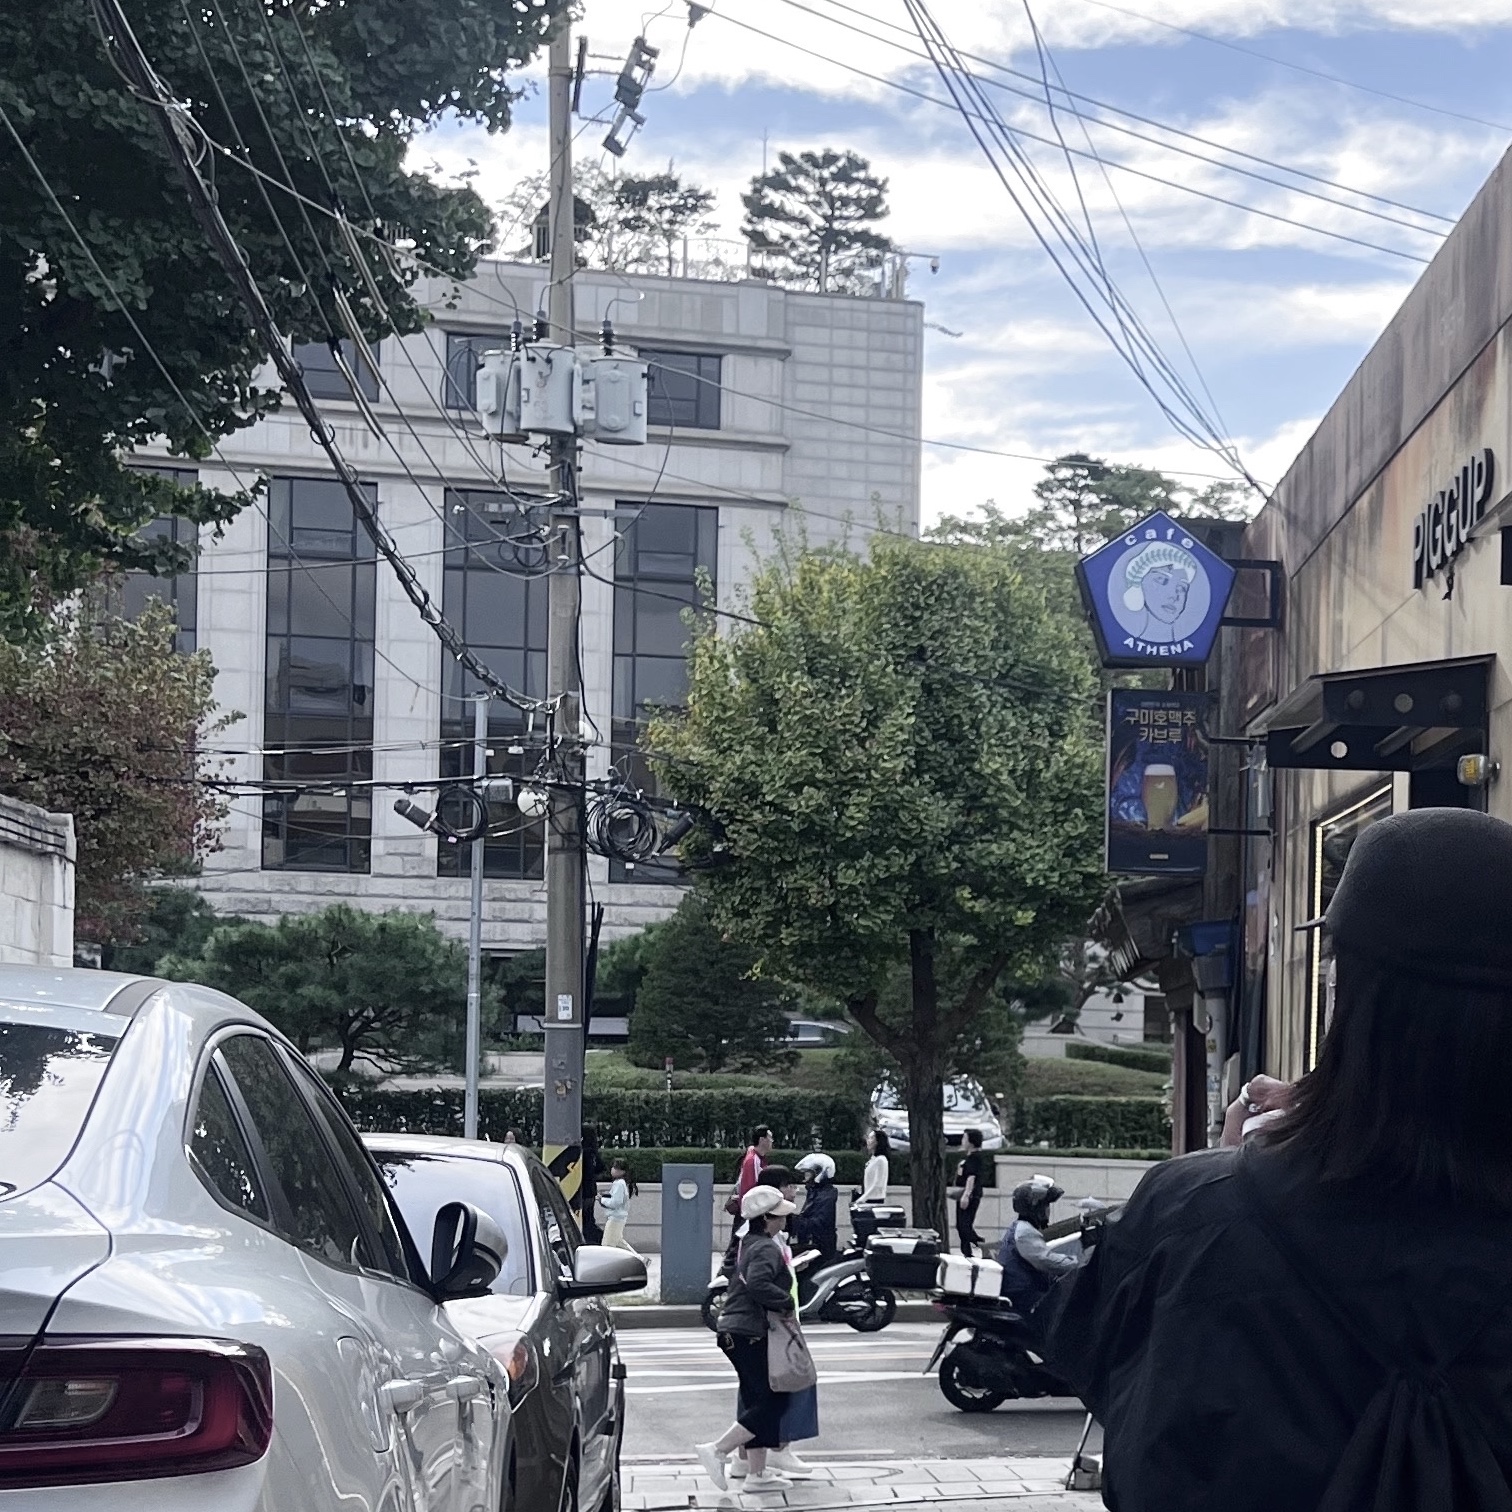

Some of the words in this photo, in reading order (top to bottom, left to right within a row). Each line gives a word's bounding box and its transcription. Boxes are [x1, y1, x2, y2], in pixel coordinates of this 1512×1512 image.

[1413, 448, 1495, 590] PIGGUP
[1124, 528, 1194, 549] cafe
[1123, 637, 1194, 656] ATHENA
[1125, 708, 1197, 727] 구미호맥주
[1139, 727, 1182, 744] 카브루
